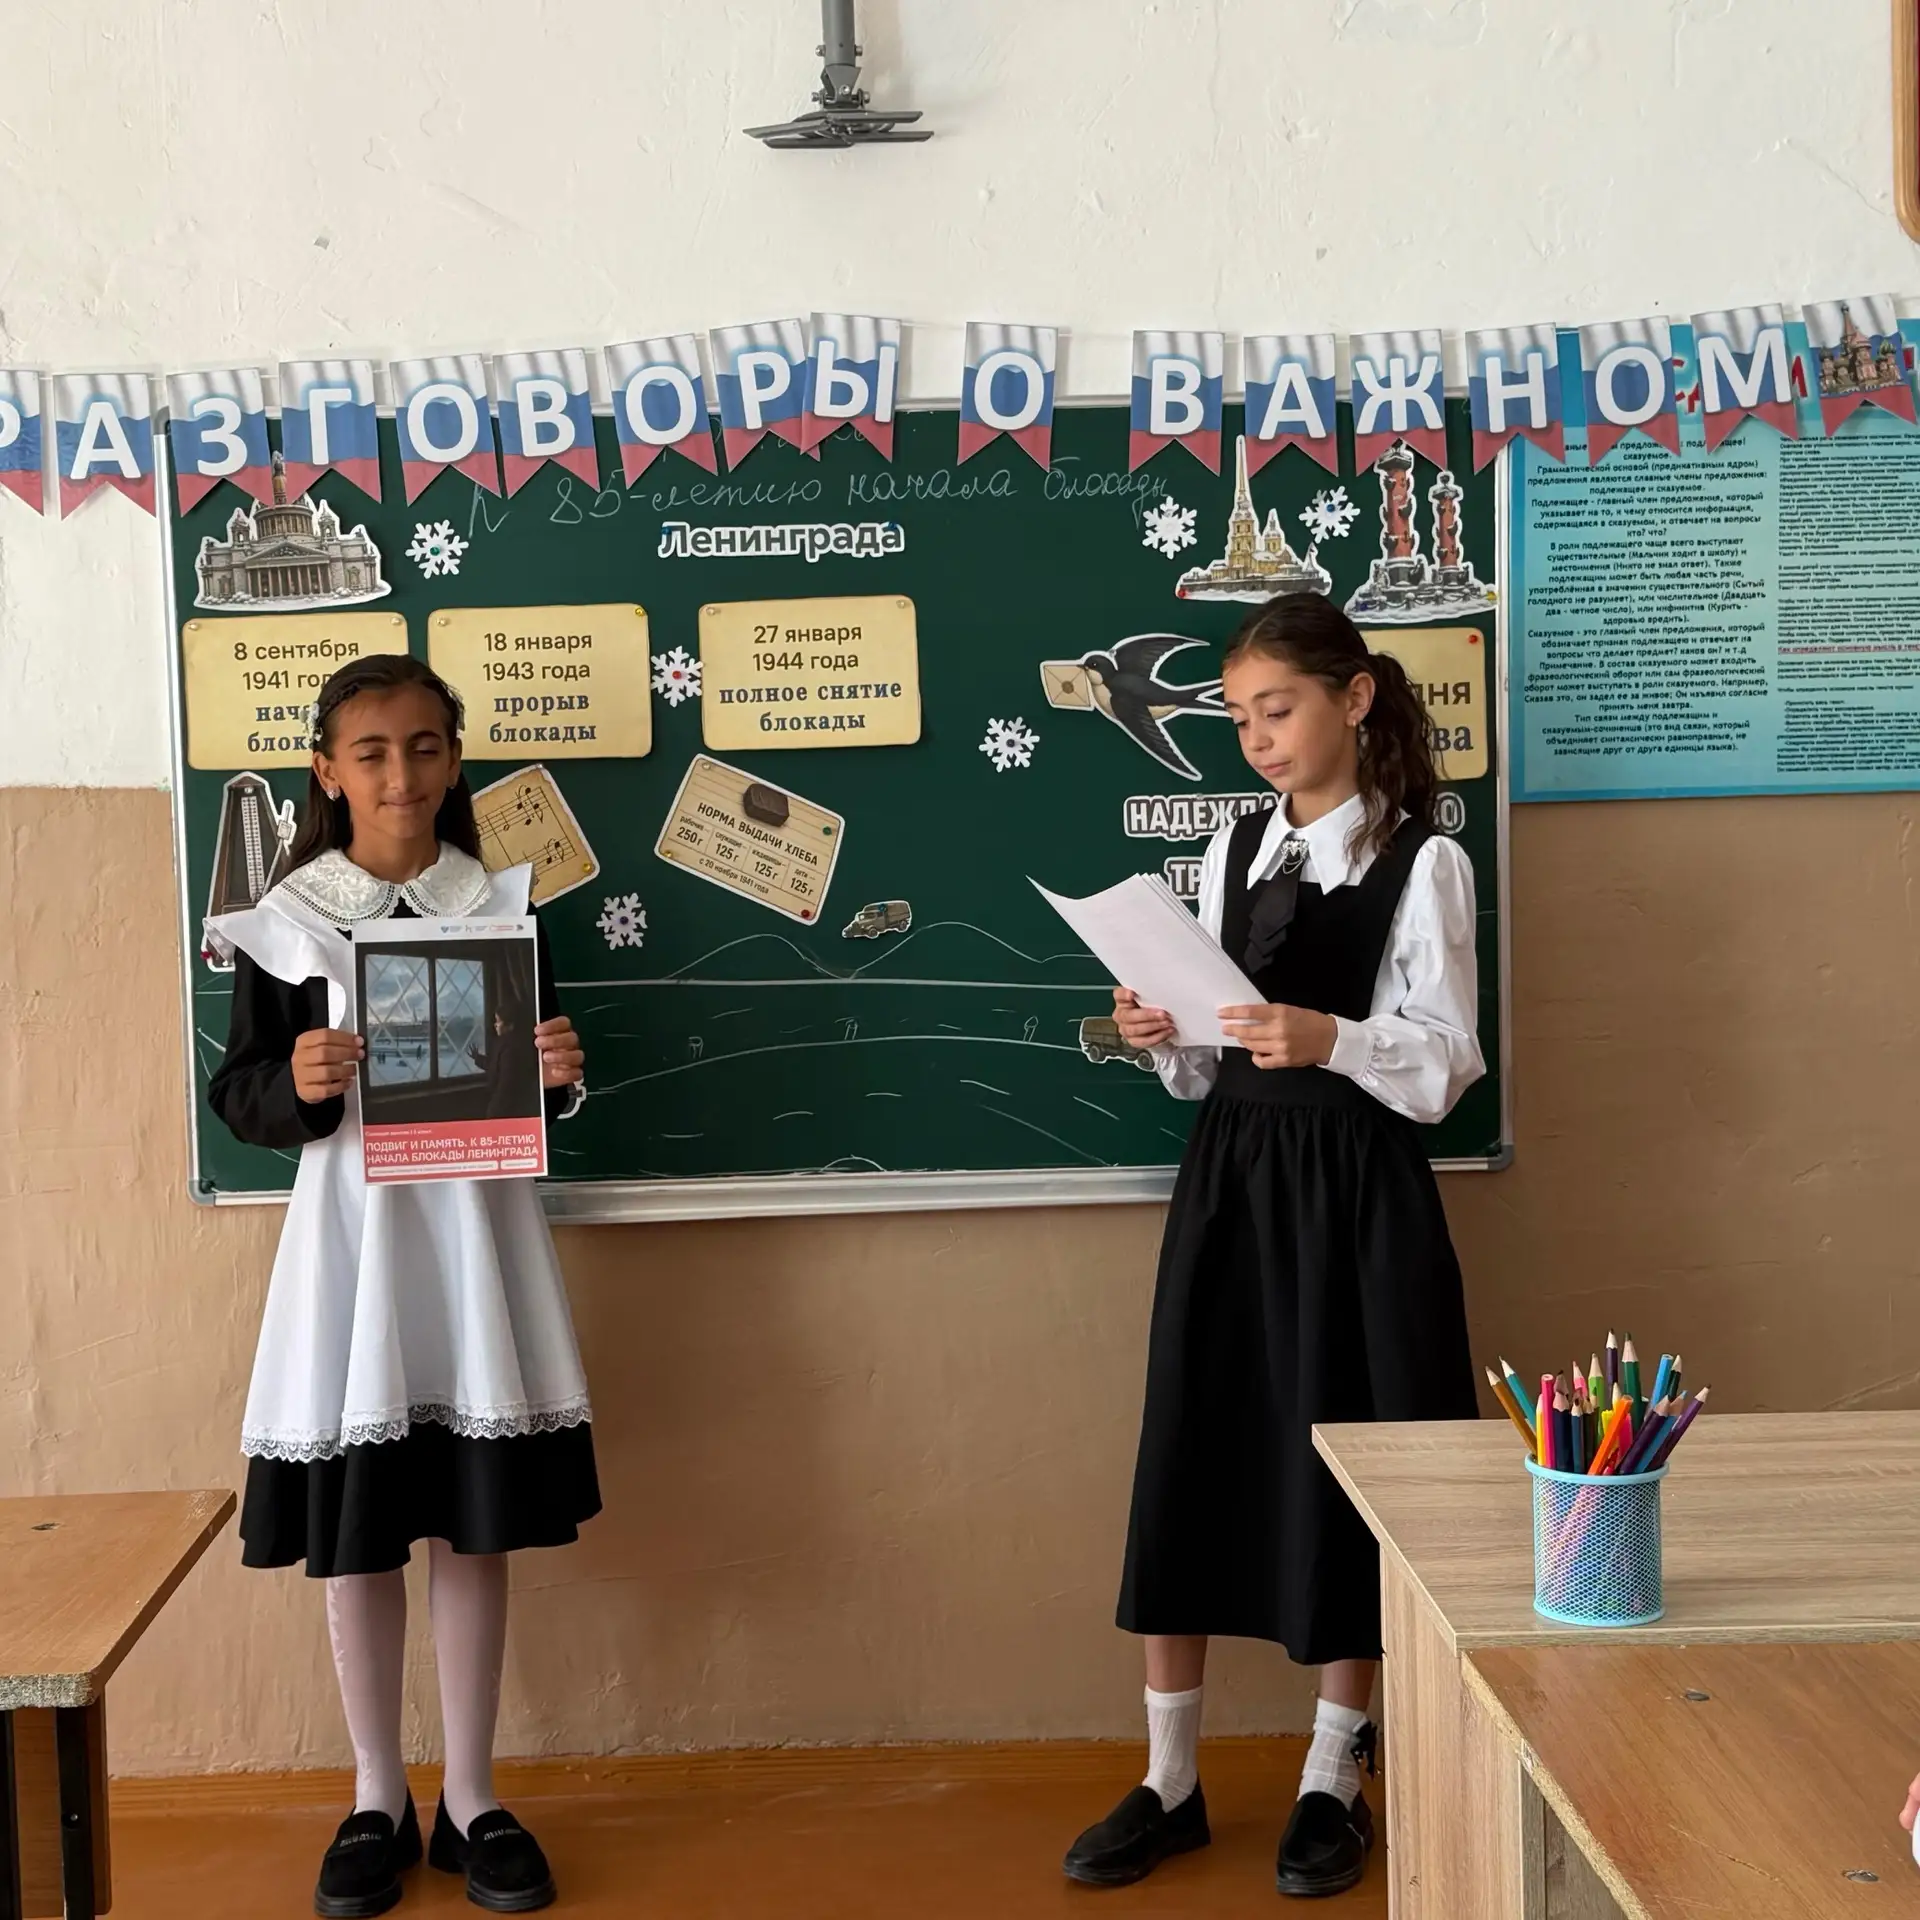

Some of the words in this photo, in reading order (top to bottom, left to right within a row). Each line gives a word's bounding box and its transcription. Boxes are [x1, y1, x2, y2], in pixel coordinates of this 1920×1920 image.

[974, 351, 1044, 431] О
[1150, 328, 1792, 440] ВАЖНОМ
[1600, 509, 1614, 517] то,
[1623, 508, 1647, 516] чему
[660, 524, 902, 560] Ленинграда
[1626, 528, 1647, 537] кто?
[1647, 528, 1668, 536] что?
[1549, 542, 1557, 552] В
[1557, 543, 1580, 552] роли
[1644, 540, 1668, 548] чаще
[1644, 561, 1656, 569] не
[1639, 572, 1662, 580] быть
[754, 625, 779, 644] 27
[785, 625, 862, 646] января
[1638, 627, 1661, 636] член
[234, 642, 248, 661] 8
[255, 639, 360, 661] сентября
[484, 633, 507, 651] 18
[515, 635, 592, 654] января
[752, 652, 803, 671] 1944
[810, 652, 860, 671] года
[1598, 660, 1605, 668] В
[242, 670, 289, 690] 1941
[482, 662, 534, 681] 1943
[542, 664, 590, 682] года
[719, 686, 808, 704] полное
[817, 682, 903, 699] снятие
[1641, 681, 1664, 690] роли
[494, 695, 590, 717] прорыв
[760, 711, 866, 732] блокады
[489, 722, 597, 743] блокады
[676, 826, 698, 844] 250
[697, 802, 736, 829] НОРМА
[738, 823, 783, 849] ВЫДАЧИ
[784, 843, 819, 867] ХЛЕБА
[715, 842, 734, 860] 125
[704, 859, 714, 869] 20
[753, 861, 773, 880] 125
[789, 877, 809, 894] 125
[366, 1140, 407, 1153] ПОДВИГ
[410, 1140, 418, 1149] И
[420, 1138, 467, 1150] ПАМЯТЬ.
[470, 1137, 477, 1146] К
[480, 1134, 536, 1146] 85-ЛЕТИЮ
[366, 1153, 409, 1164] НАЧАЛА
[411, 1150, 465, 1163] БЛОКАДЫ
[467, 1146, 538, 1160] ЛЕНИНГРАДА
